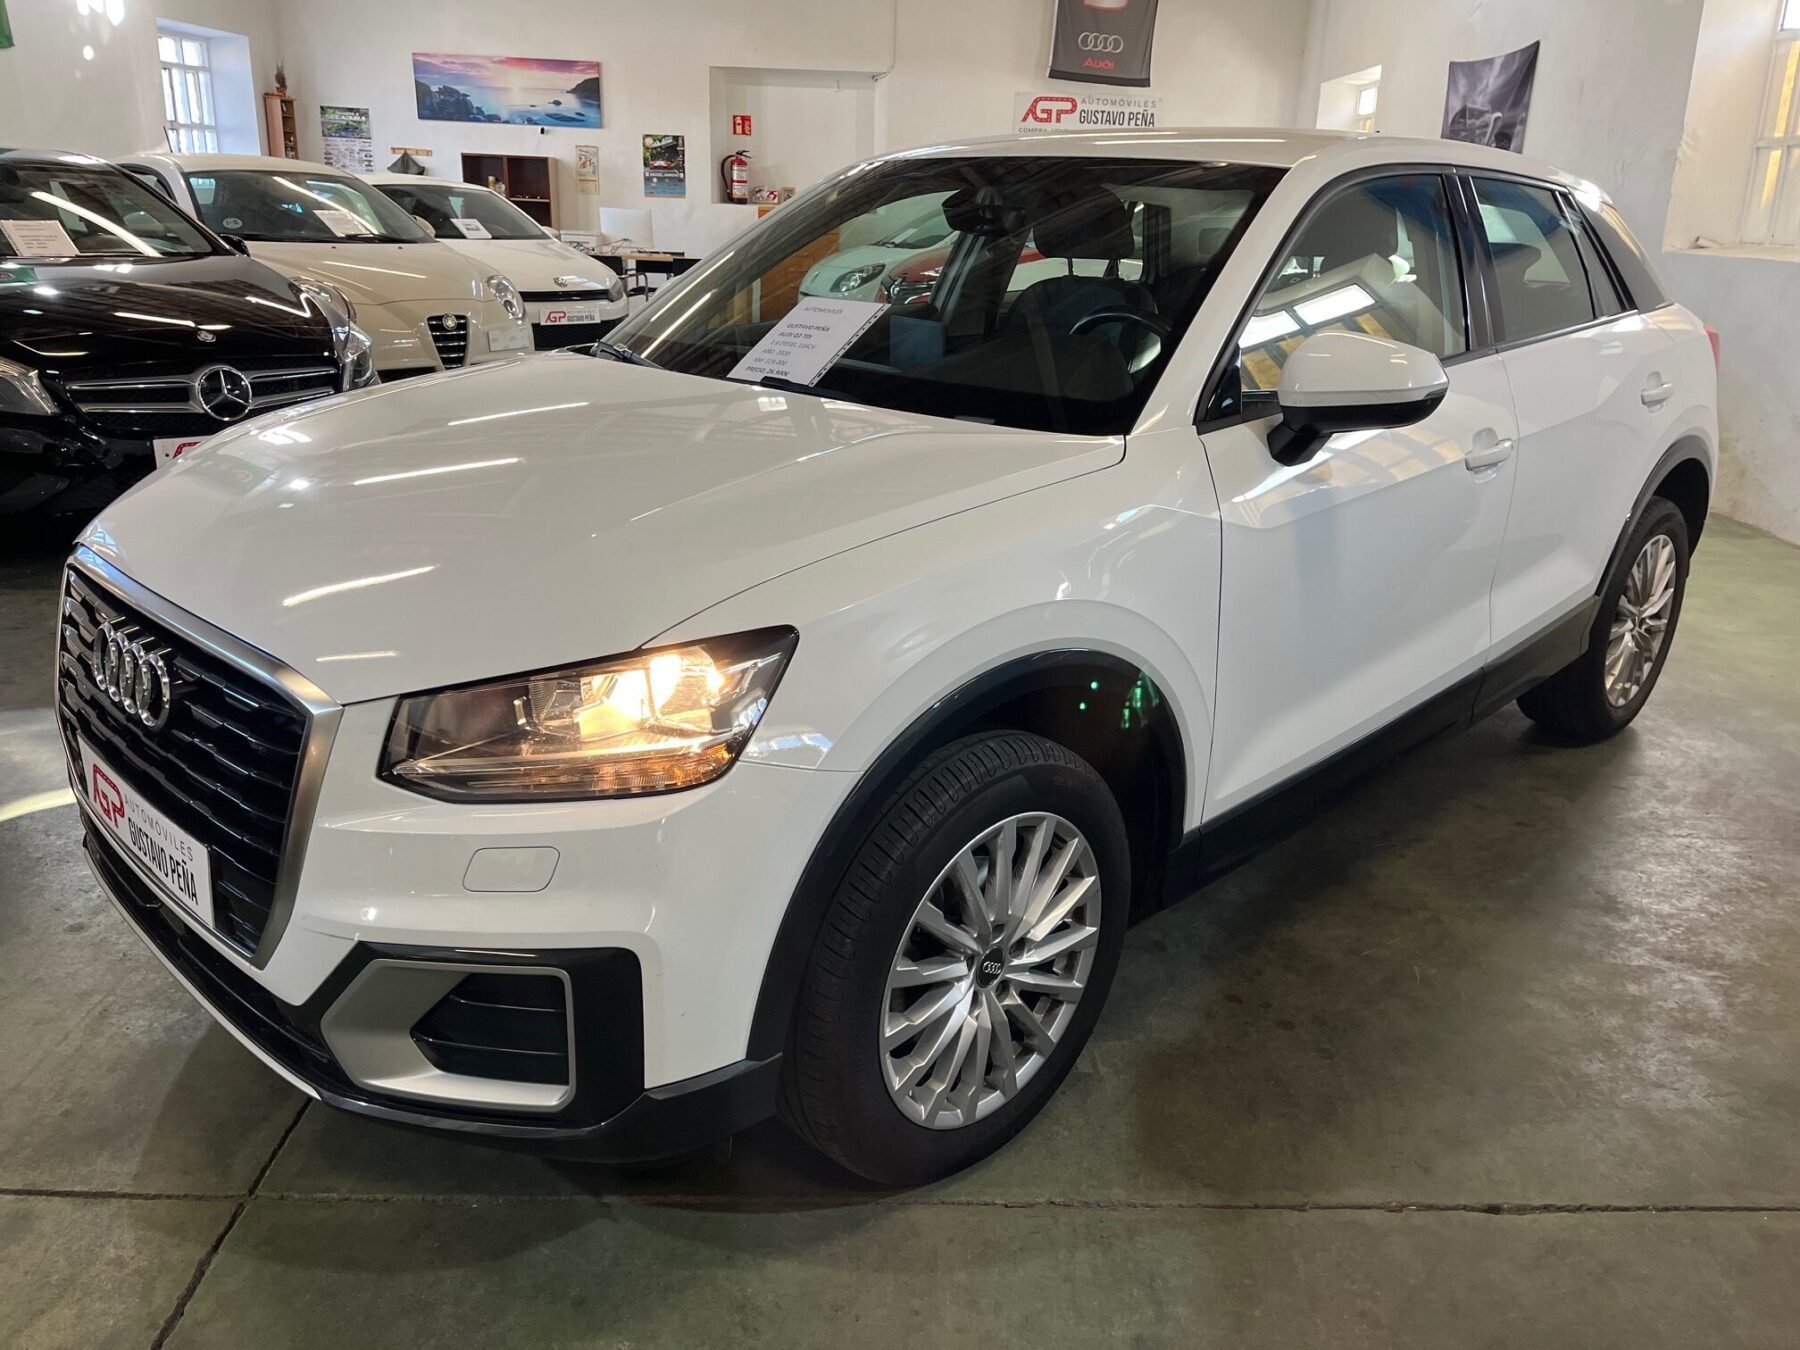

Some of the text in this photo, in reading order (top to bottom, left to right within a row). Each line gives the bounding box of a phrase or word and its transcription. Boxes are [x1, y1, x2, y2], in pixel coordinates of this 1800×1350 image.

[1079, 109, 1155, 128] GUSTAVO PEÑA
[128, 816, 199, 906] GUSTAVO PEÑA
